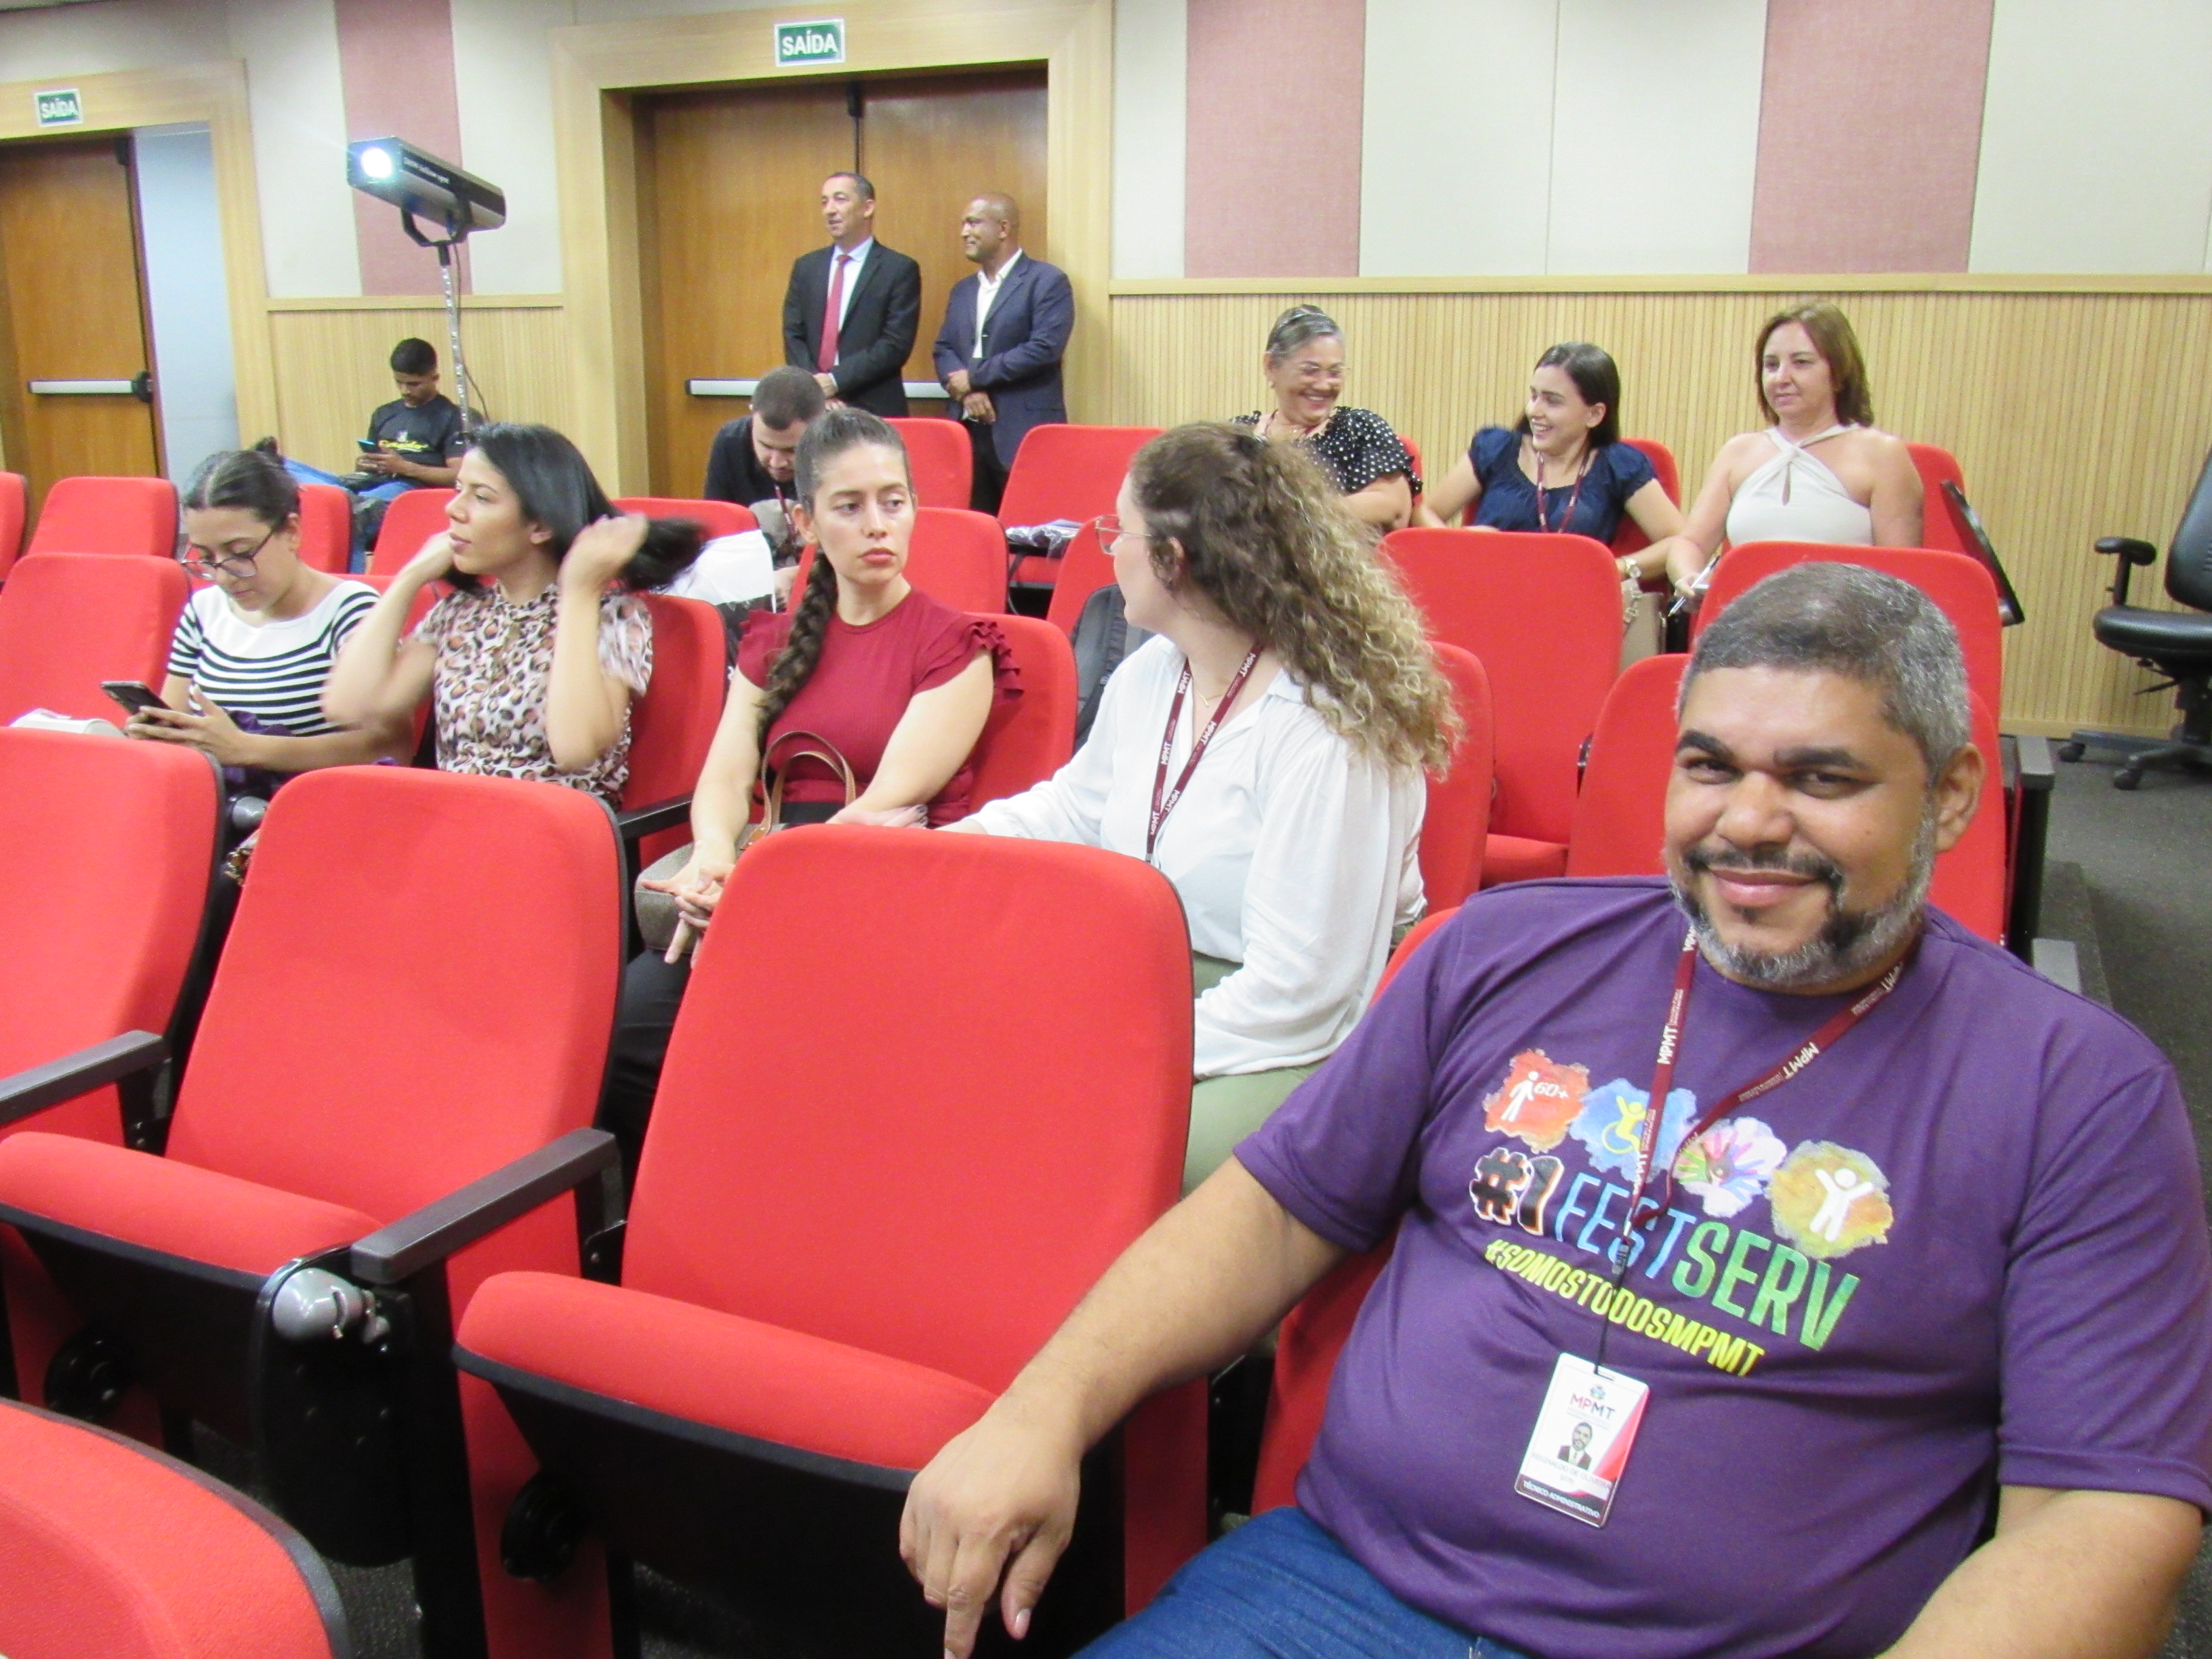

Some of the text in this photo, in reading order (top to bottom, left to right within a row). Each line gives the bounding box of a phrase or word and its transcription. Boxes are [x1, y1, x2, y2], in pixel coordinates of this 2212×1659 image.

[781, 29, 838, 56] SAÍDA
[41, 98, 78, 119] SAÍDA
[1239, 652, 1256, 677] MPMT
[1177, 671, 1191, 695] MPMT
[1200, 720, 1217, 745] MPMT
[1160, 741, 1171, 766] MPMT
[1164, 790, 1180, 813] MPMT
[1656, 1024, 1679, 1065] MPMT
[1782, 1041, 1820, 1080] MPMT
[1534, 1082, 1570, 1099] 60+
[1483, 1238, 1766, 1377] #SOMOSTODOSMPMT
[1570, 1393, 1616, 1420] MPMT
